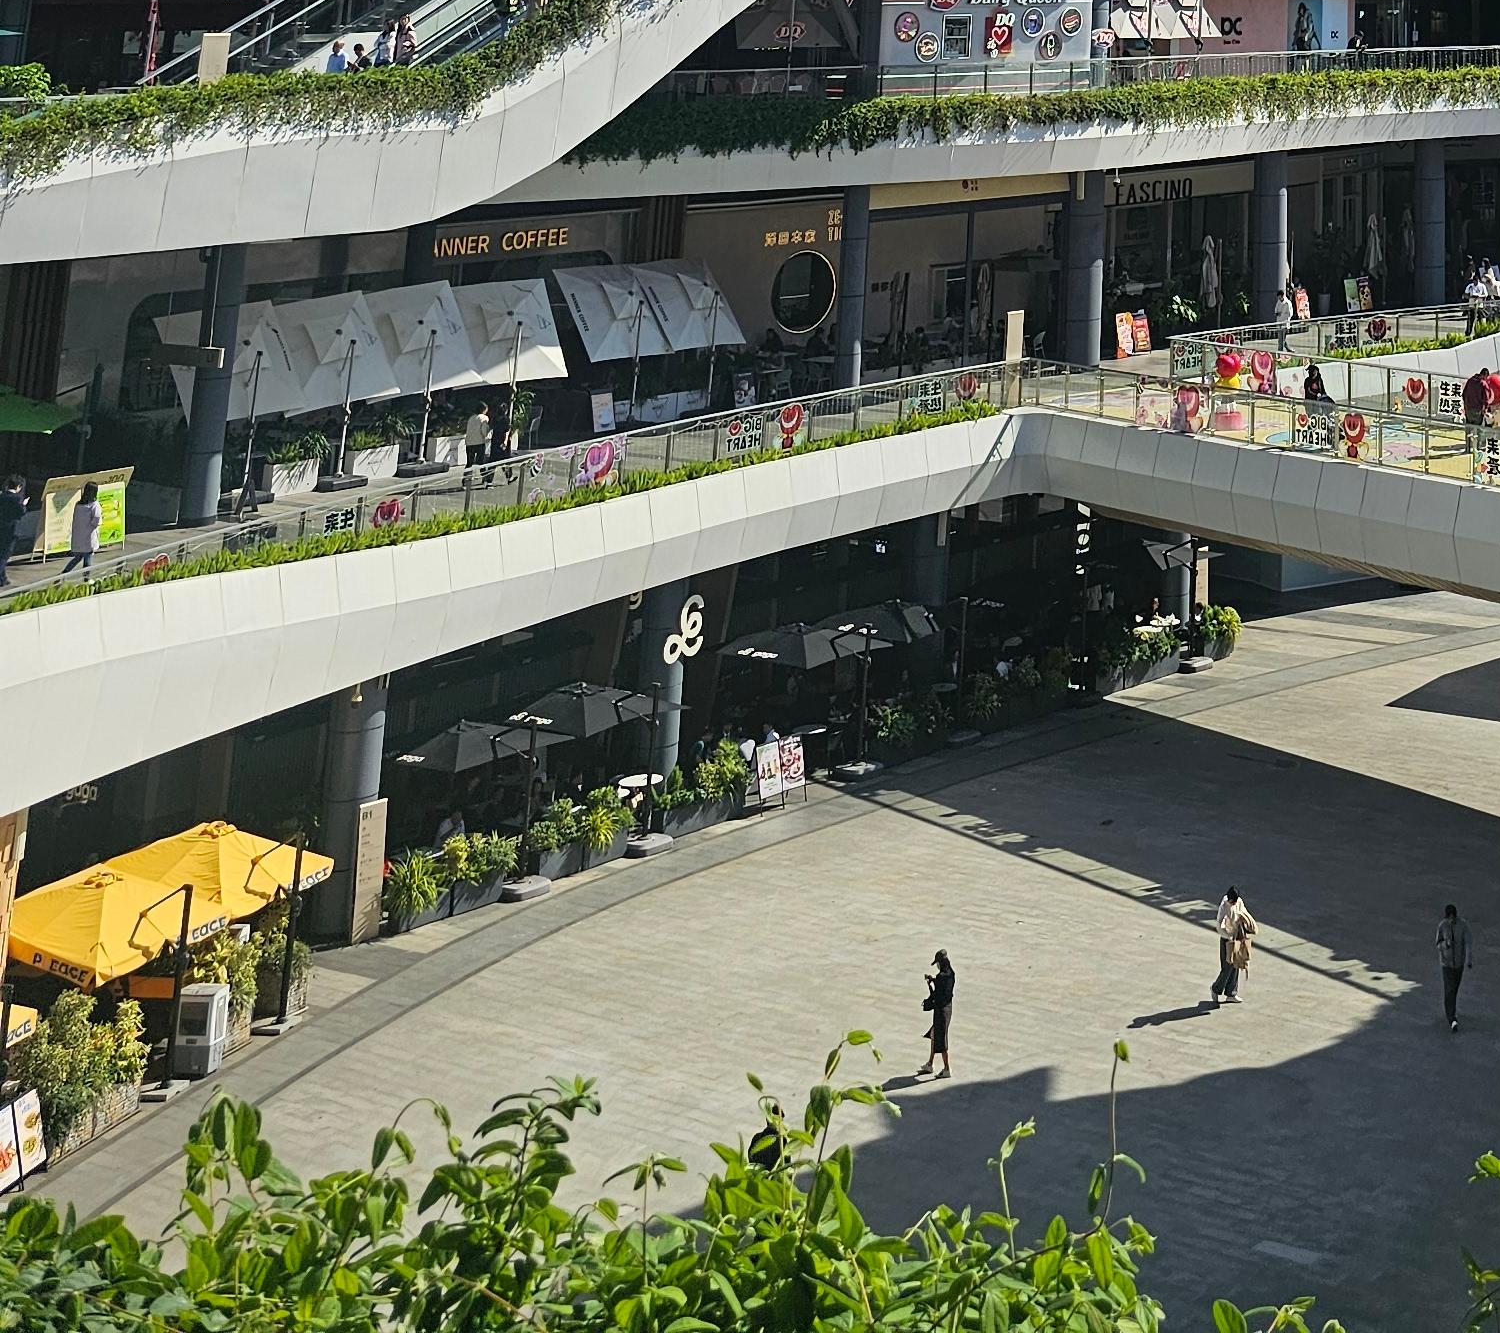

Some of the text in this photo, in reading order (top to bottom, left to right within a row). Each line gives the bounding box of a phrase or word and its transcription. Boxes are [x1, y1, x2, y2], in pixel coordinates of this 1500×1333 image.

[995, 12, 1016, 26] DQ
[1115, 178, 1193, 205] FASCINO
[502, 227, 569, 251] COFFEE
